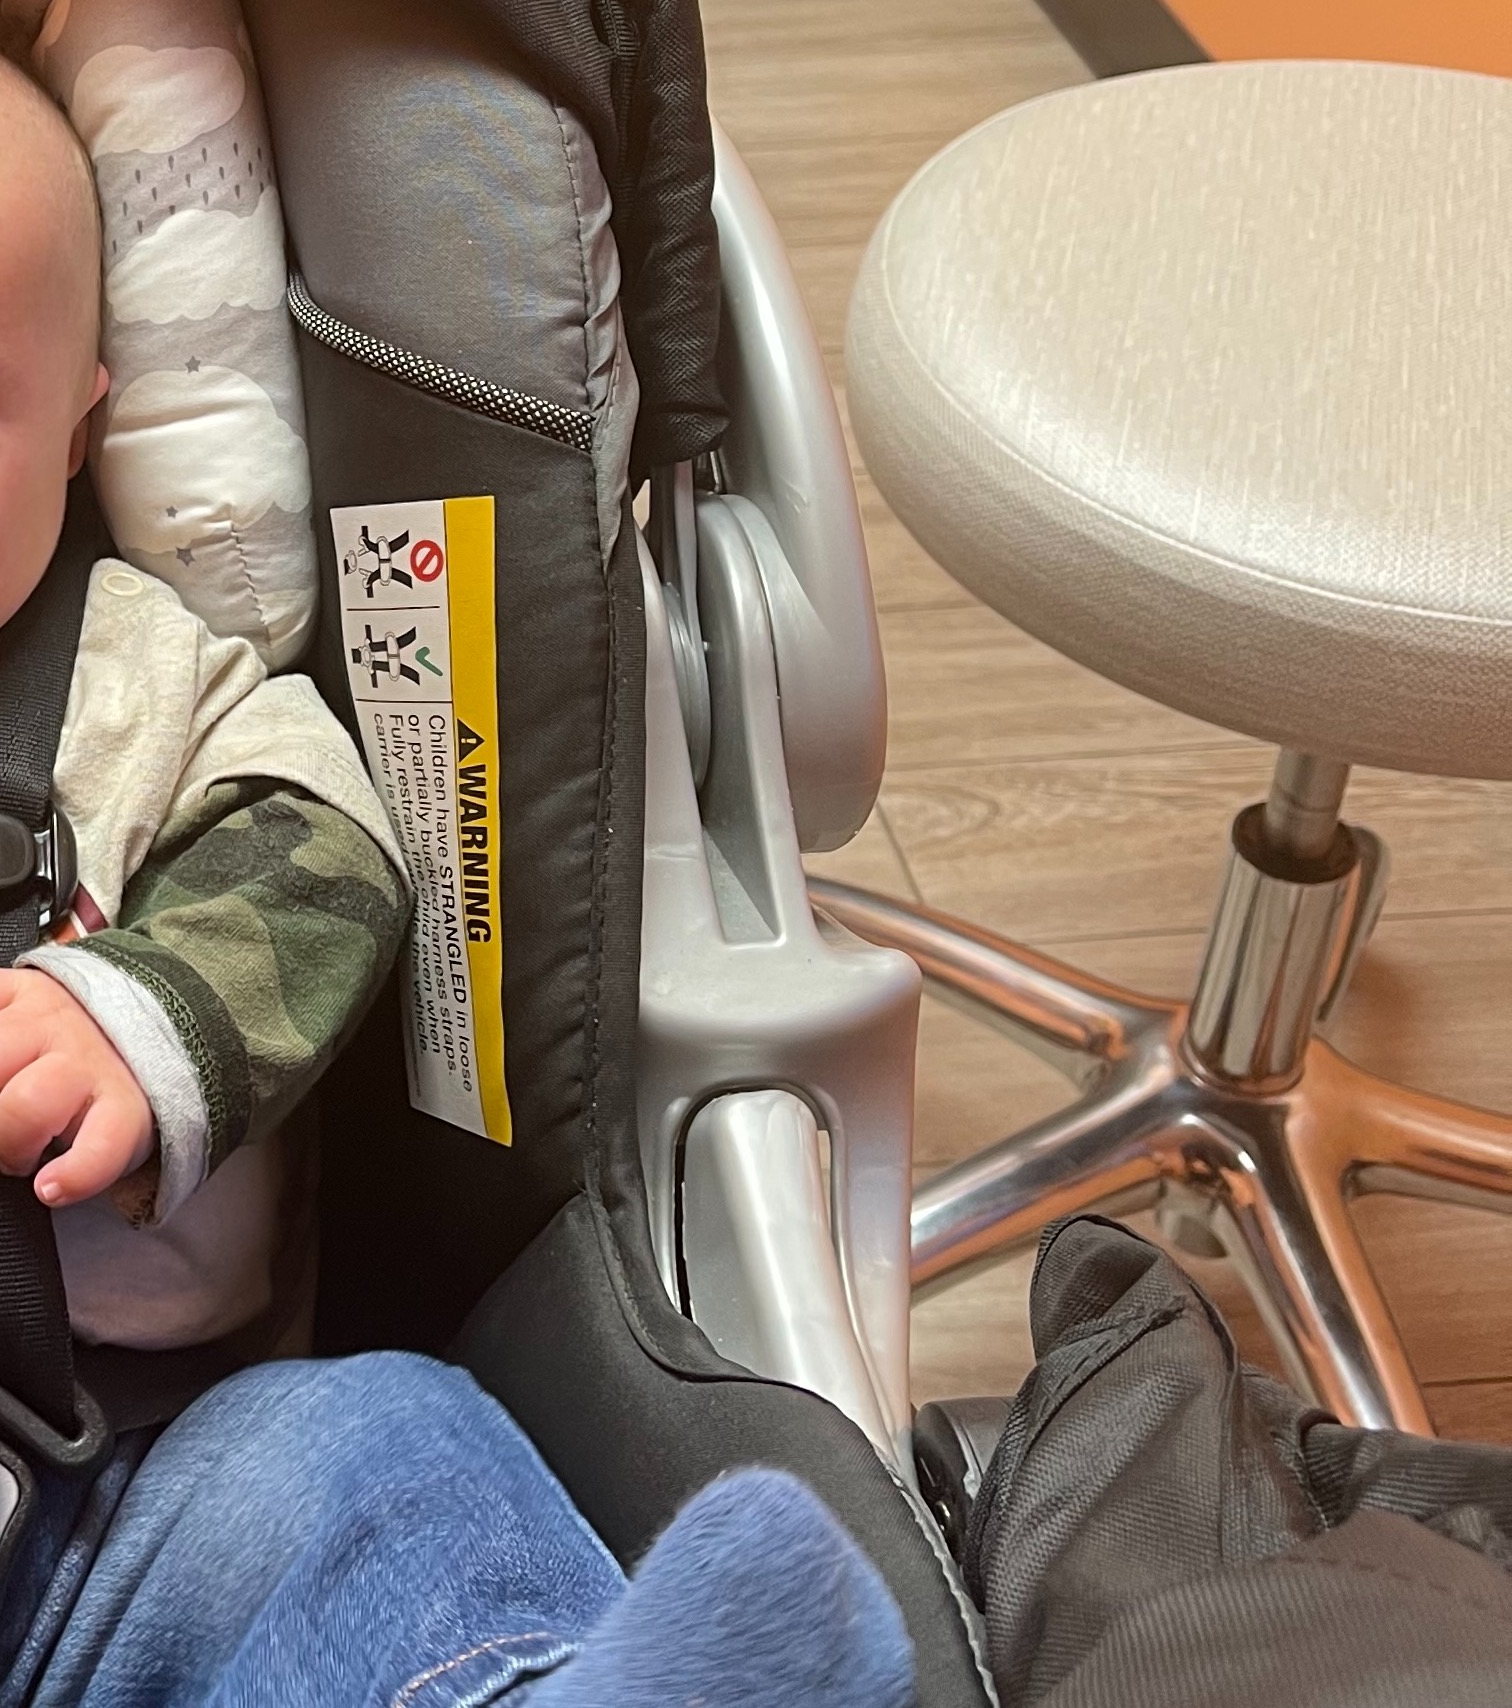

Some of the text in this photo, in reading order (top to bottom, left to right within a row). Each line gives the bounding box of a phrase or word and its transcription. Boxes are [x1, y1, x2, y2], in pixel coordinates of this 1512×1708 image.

[374, 713, 392, 777] carrier
[386, 784, 396, 799] is
[391, 806, 410, 854] used
[459, 764, 491, 943] WARNING
[389, 715, 441, 1053] Fully restrain the child even when
[408, 714, 456, 1076] or partially buckled harness straps.
[429, 715, 472, 1092] Children have STRANGLED in loose
[412, 942, 420, 972] the
[414, 981, 428, 1054] vehicle.
